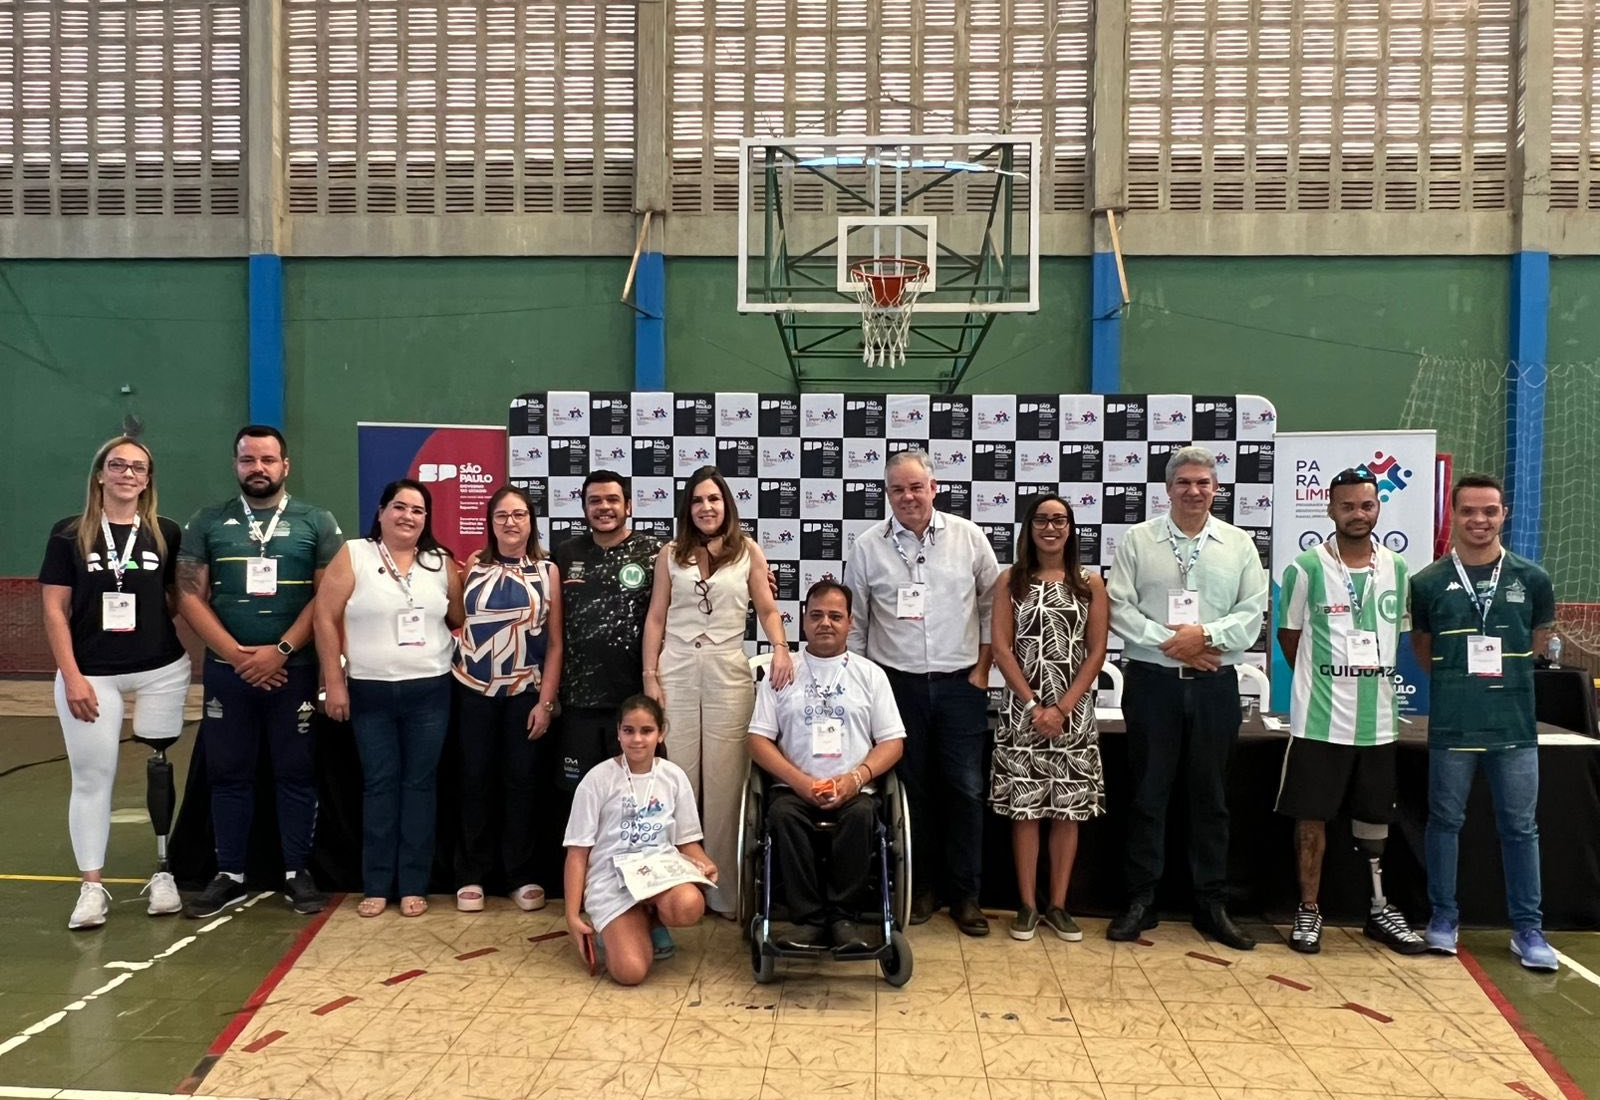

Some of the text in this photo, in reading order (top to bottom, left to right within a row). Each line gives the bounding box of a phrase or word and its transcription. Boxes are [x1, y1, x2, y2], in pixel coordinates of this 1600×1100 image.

[460, 463, 481, 473] SÃO
[1296, 460, 1320, 472] PA
[460, 474, 493, 483] PAULO
[1296, 475, 1320, 488] RA
